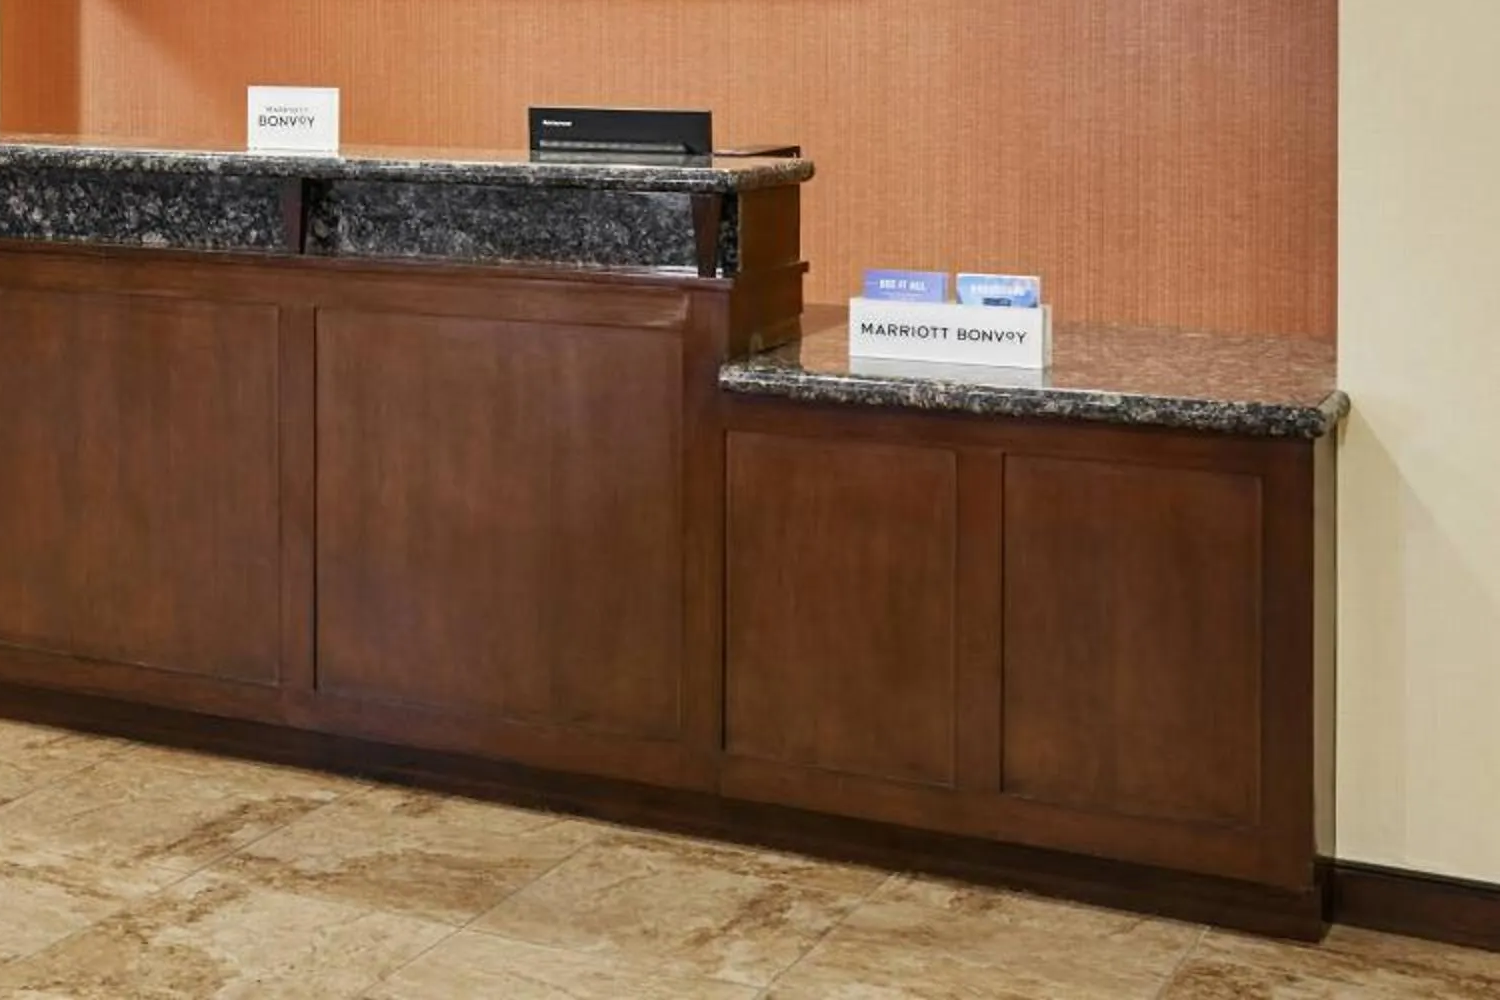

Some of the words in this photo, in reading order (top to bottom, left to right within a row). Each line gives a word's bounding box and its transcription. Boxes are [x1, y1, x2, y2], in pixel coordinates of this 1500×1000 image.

[258, 115, 315, 128] BONVOY
[860, 322, 949, 340] MARRIOTT
[957, 327, 1027, 344] BONVOY
